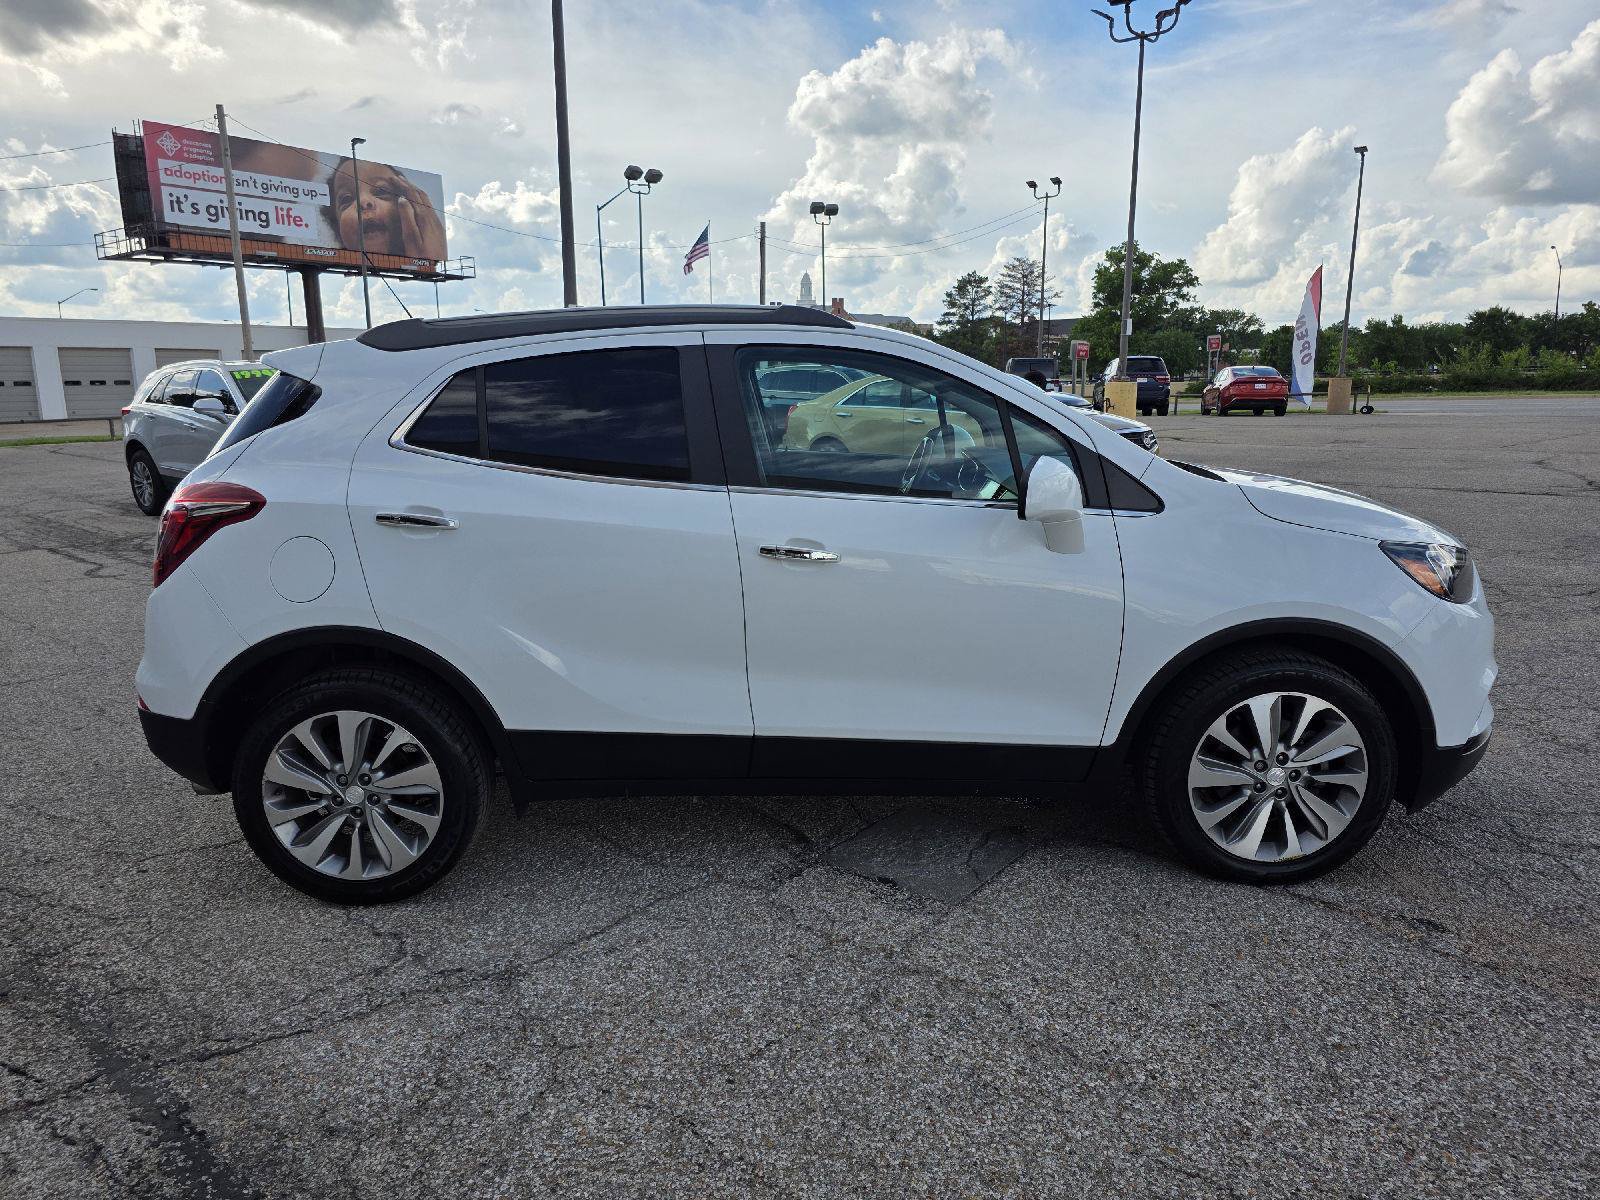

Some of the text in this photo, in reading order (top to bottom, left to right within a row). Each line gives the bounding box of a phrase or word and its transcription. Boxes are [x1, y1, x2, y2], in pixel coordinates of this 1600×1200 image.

[234, 175, 258, 190] sn't
[260, 179, 300, 199] giving
[168, 192, 201, 215] it's
[274, 205, 310, 229] life.
